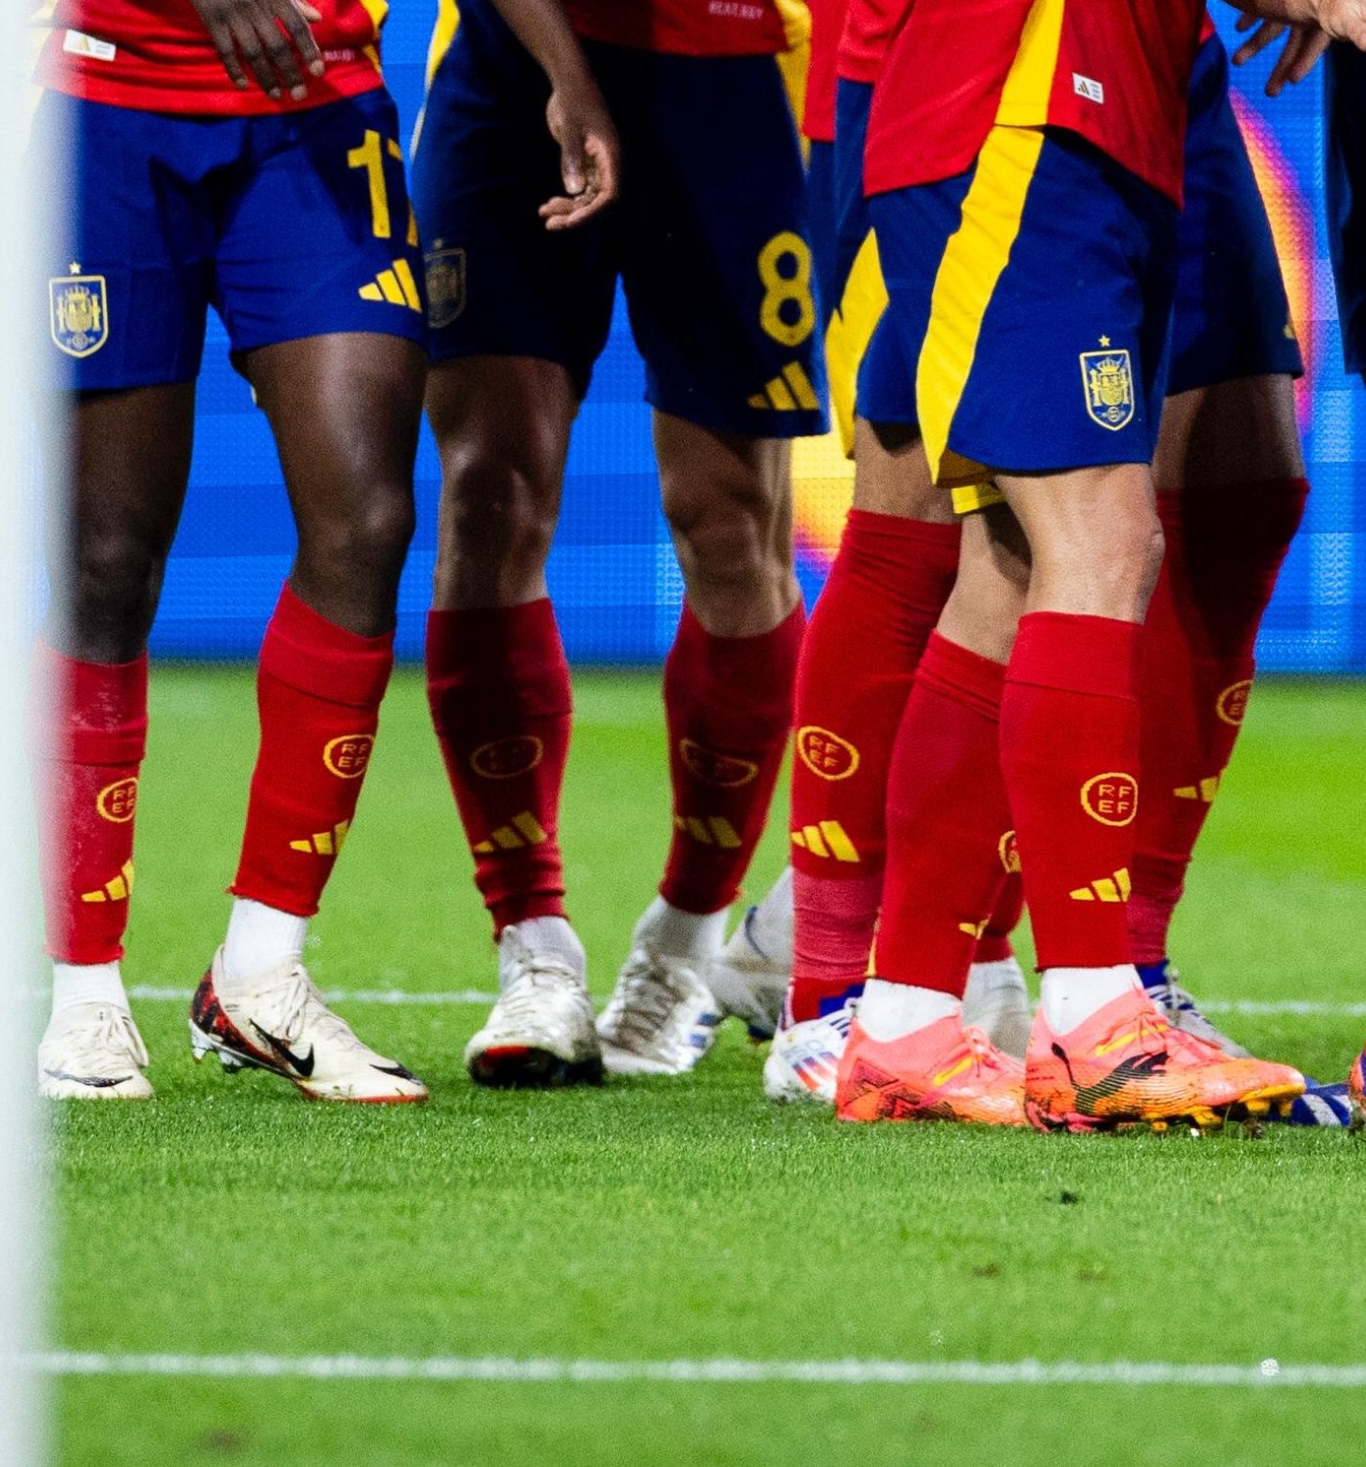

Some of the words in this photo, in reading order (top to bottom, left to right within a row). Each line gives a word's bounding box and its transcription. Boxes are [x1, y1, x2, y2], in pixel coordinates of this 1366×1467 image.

[757, 231, 816, 346] 8
[1098, 784, 1132, 798] RF
[1098, 799, 1130, 814] EF
